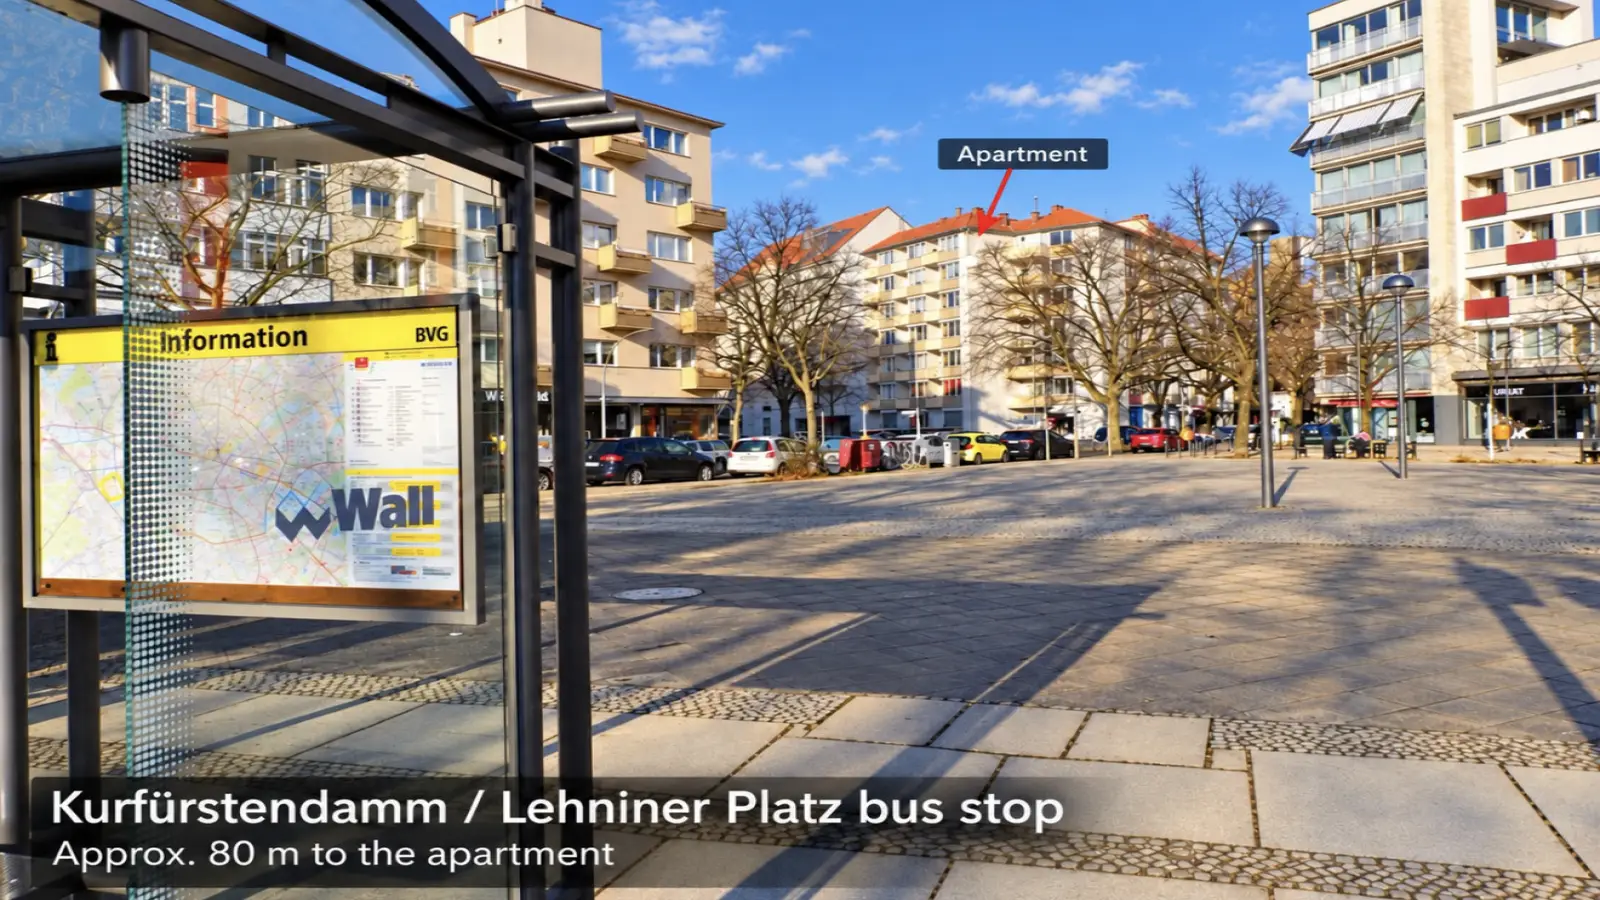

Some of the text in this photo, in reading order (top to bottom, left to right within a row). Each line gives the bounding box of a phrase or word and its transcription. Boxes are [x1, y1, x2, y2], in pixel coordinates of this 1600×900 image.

[160, 325, 308, 353] Information
[415, 325, 448, 343] BVG
[331, 485, 435, 532] Wall
